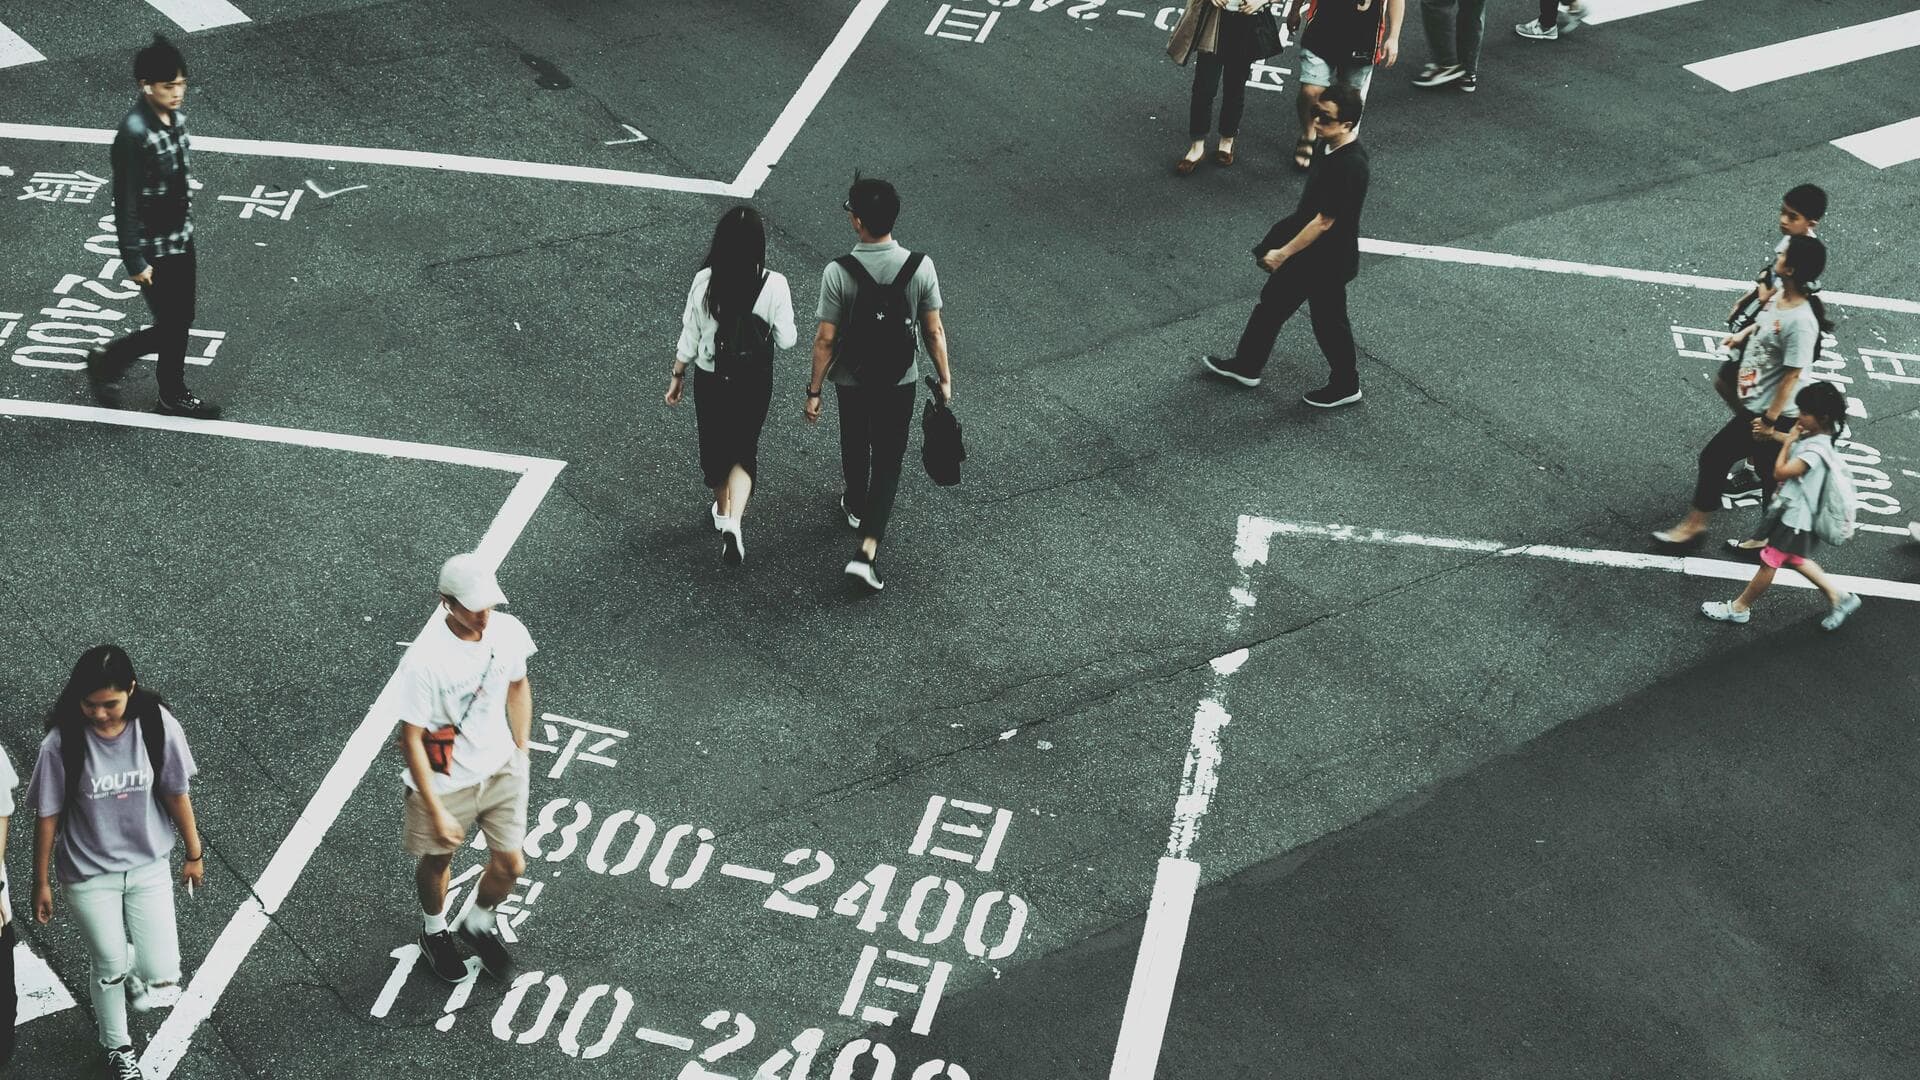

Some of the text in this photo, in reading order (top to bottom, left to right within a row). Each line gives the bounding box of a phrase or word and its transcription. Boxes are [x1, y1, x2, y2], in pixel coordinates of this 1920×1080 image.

[90, 768, 150, 794] YOUTH
[470, 797, 1030, 960] 800-2400
[908, 795, 1013, 872] 日
[368, 943, 972, 1080] 1100-240
[838, 946, 953, 1036] 日
